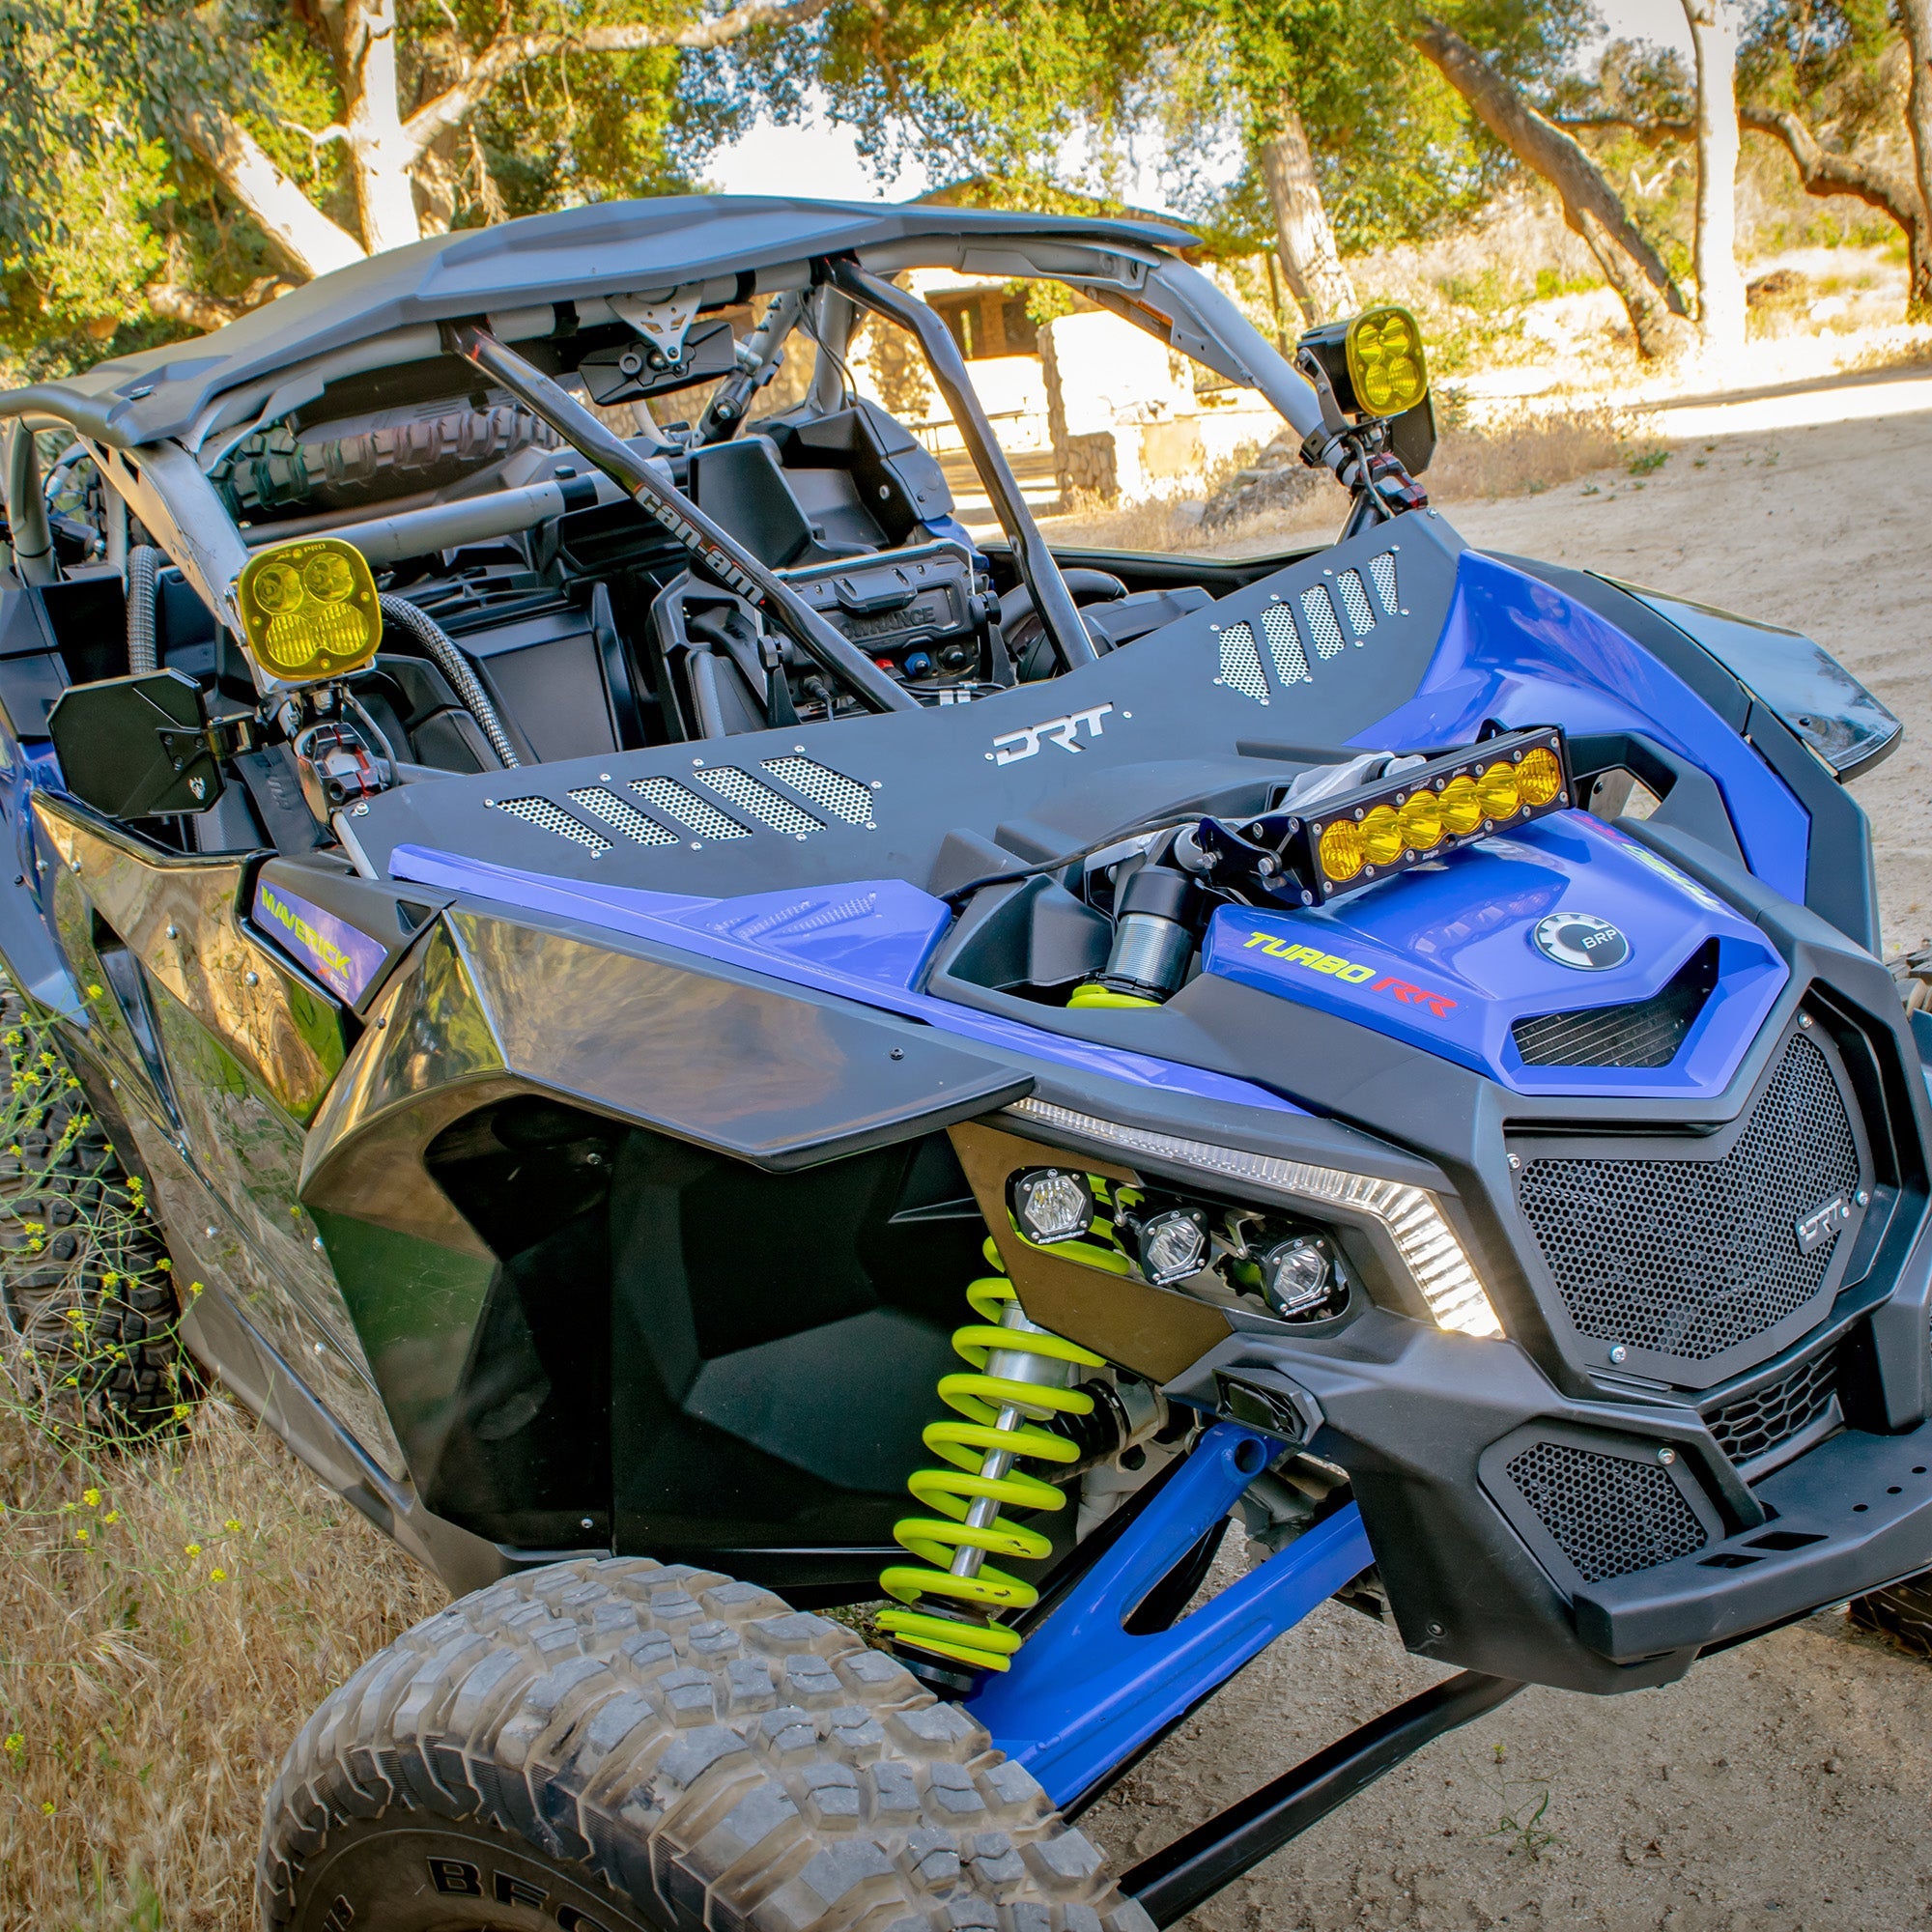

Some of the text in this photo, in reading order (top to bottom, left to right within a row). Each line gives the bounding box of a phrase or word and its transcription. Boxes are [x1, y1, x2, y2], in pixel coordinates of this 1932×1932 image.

[302, 542, 327, 554] PRO
[634, 484, 765, 606] can-am
[838, 606, 936, 639] OWRANCE
[993, 701, 1114, 766] DRT
[261, 885, 352, 980] MAVERICK
[1581, 929, 1617, 949] BRP
[1243, 931, 1458, 1019] TURBO RR
[1804, 1198, 1843, 1242] DRT
